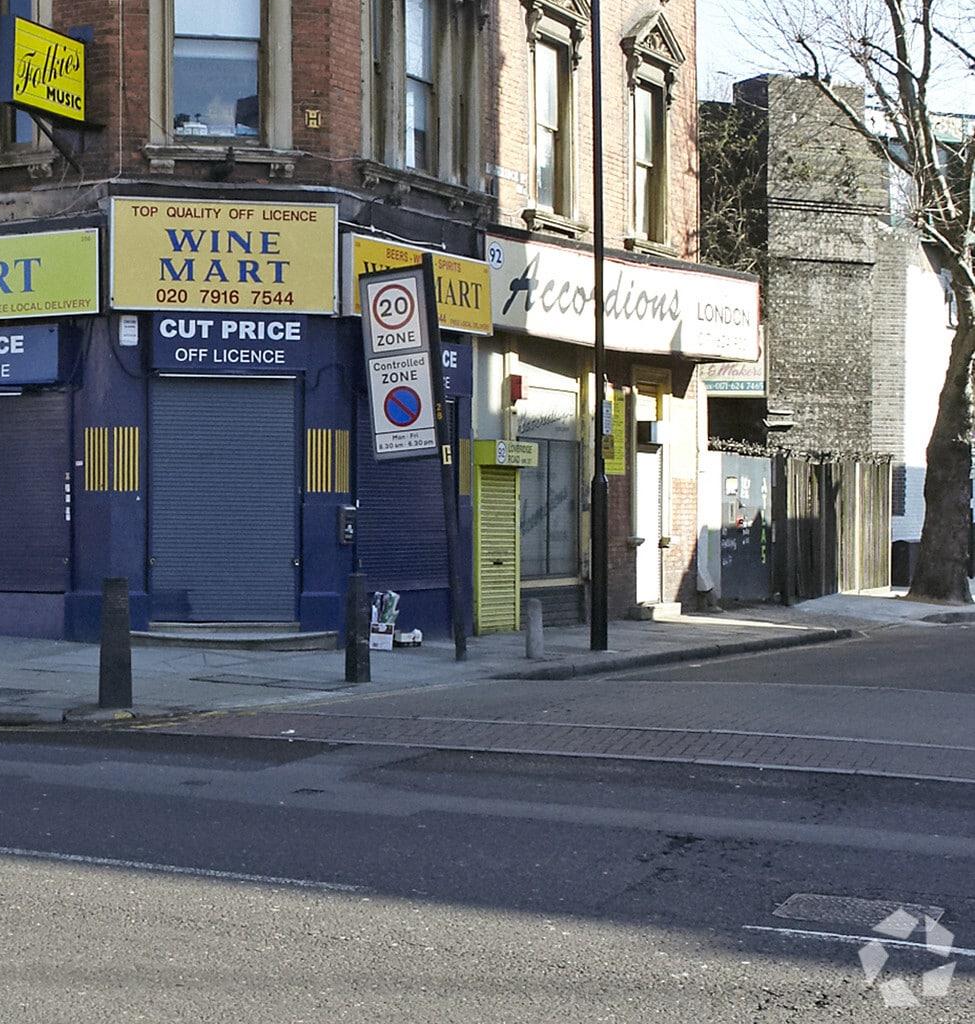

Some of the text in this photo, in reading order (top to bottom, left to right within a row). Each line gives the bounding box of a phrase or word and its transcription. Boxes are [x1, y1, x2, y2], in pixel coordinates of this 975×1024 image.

[16, 43, 79, 95] Folkies
[47, 86, 82, 110] MUSIC
[132, 206, 317, 222] TOP QUALITY OFF LICENCE
[165, 229, 281, 255] WINE
[386, 248, 408, 263] BEERS
[490, 248, 502, 264] 92
[159, 258, 290, 284] MART
[438, 259, 462, 273] SPIRITS
[156, 289, 294, 305] 020 7916 7544
[11, 302, 42, 312] LOCAL
[45, 299, 91, 311] DELIVERY
[379, 297, 408, 317] 20
[697, 303, 750, 326] LONDON
[160, 319, 301, 341] CUT PRICE
[377, 331, 416, 347] ZONE
[175, 349, 285, 364] OFF LICENCE
[373, 356, 425, 372] Controlled
[381, 370, 418, 384] ZONE
